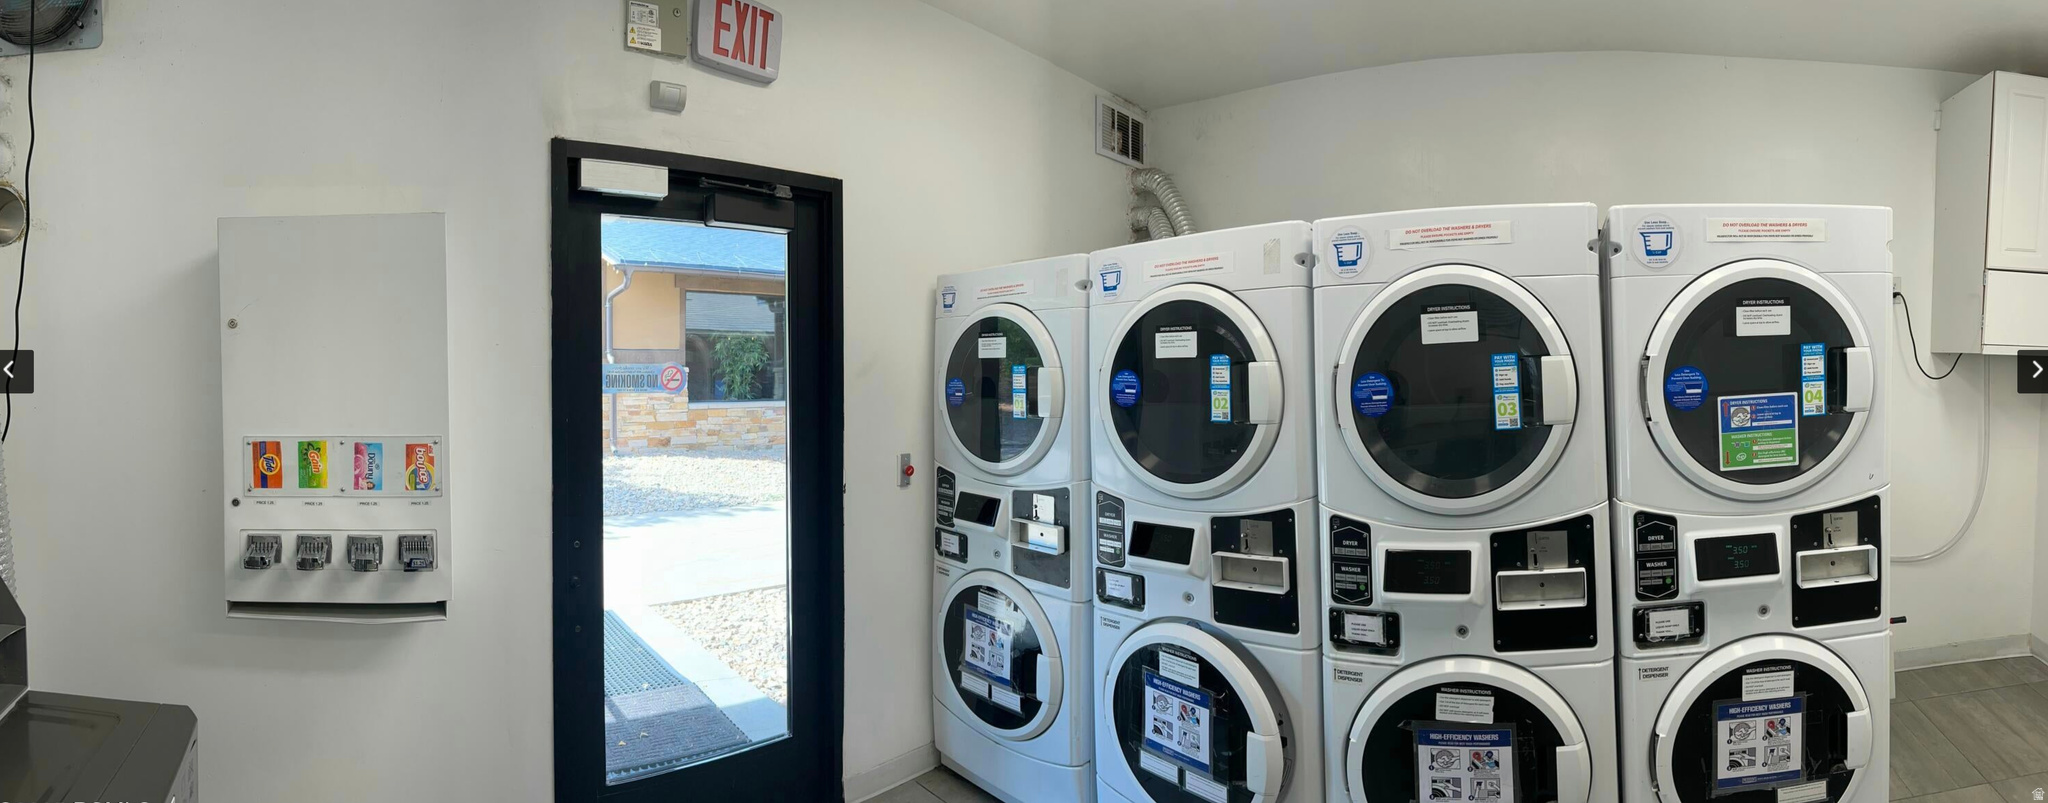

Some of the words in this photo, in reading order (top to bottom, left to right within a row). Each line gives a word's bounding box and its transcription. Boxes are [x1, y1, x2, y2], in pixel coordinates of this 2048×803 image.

[712, 0, 774, 70] EXIT
[1213, 397, 1228, 409] 02
[1805, 389, 1823, 404] 04
[1497, 402, 1517, 416] 03
[263, 456, 275, 473] Tide
[308, 450, 322, 474] Gain
[365, 453, 375, 480] Downy
[415, 447, 429, 484] bounce
[1337, 669, 1363, 677] DETERGENT
[1337, 675, 1363, 683] DISPENSER
[1729, 705, 1768, 714] HIGH-EFFICIENCY
[1769, 702, 1791, 710] WASHERS
[1430, 733, 1472, 741] HIGH-EFFICIENCY
